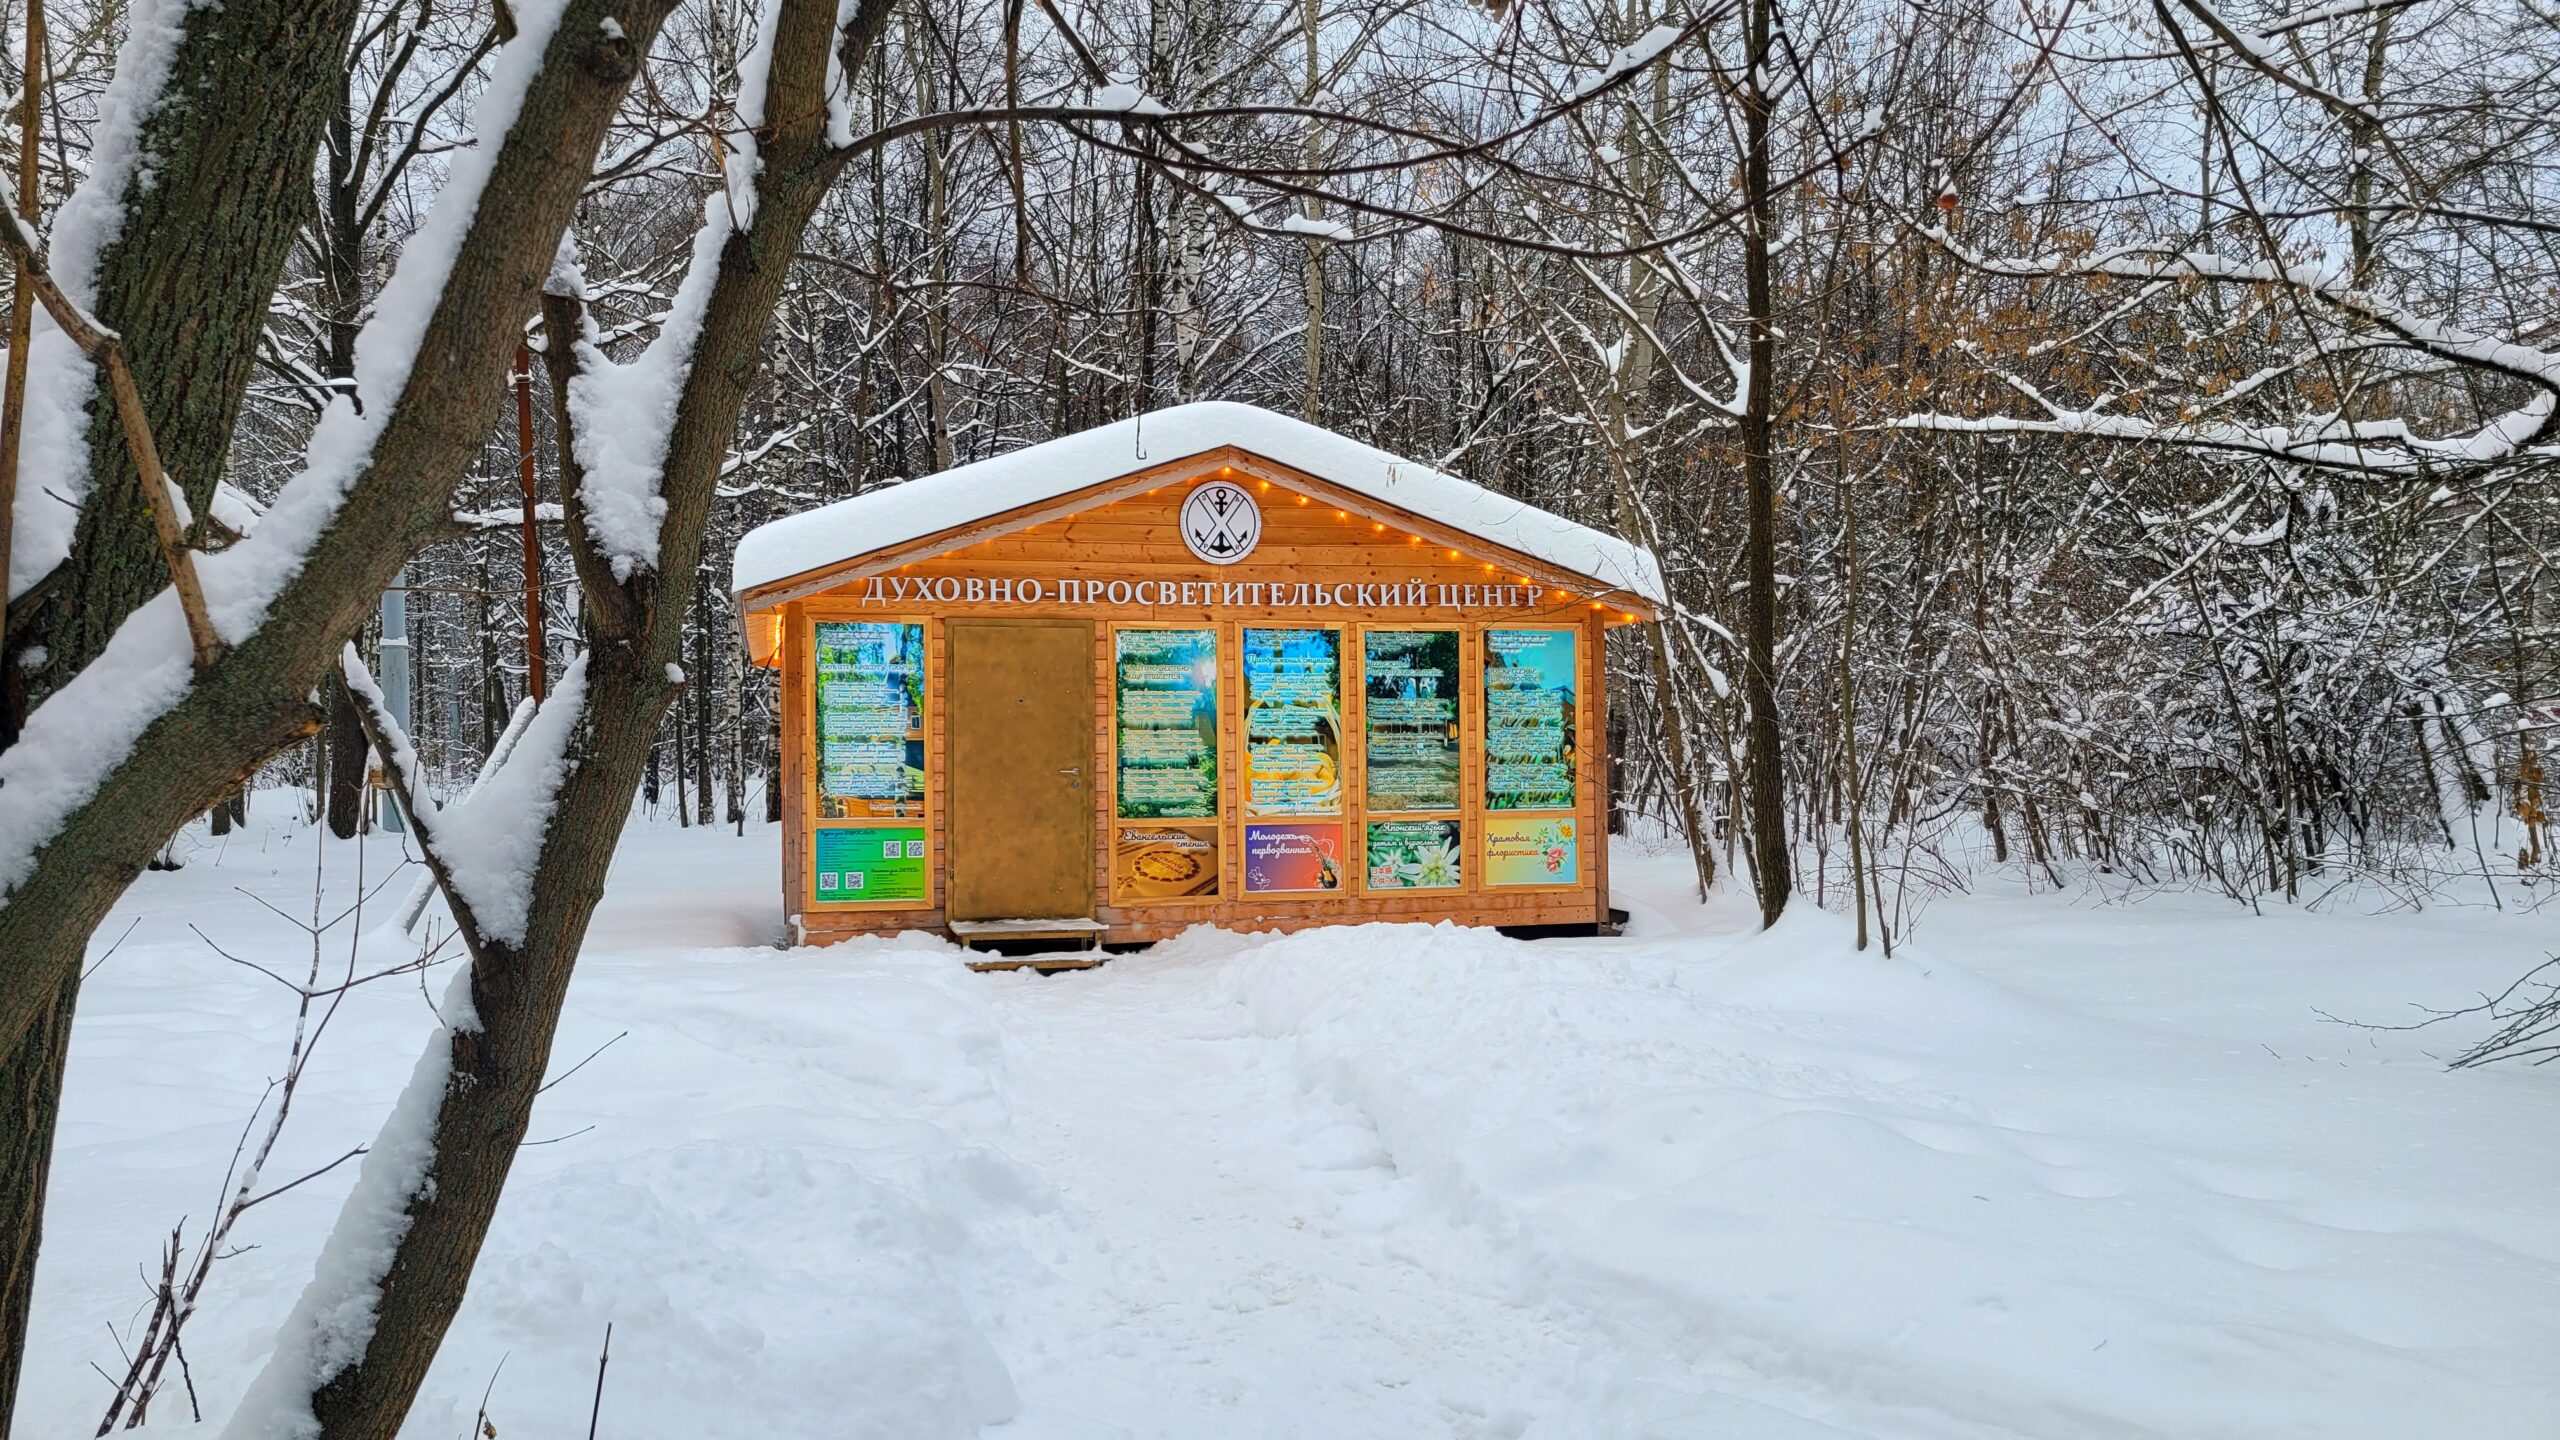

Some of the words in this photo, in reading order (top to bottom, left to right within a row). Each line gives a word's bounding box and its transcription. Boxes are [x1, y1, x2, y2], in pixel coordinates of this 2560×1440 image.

[861, 576, 1428, 607] ДУХОВНО-ПРОСВЕТИТЕЛЬСКИЙ
[1438, 583, 1544, 612] ЦЕНТР
[1123, 829, 1188, 841] Евангельские
[1381, 821, 1422, 832] Японский
[1424, 823, 1446, 835] язык
[1174, 840, 1209, 848] чтения
[1372, 840, 1398, 850] детям
[1404, 837, 1440, 850] взрослым
[1486, 832, 1531, 847] Храмовая
[1251, 843, 1312, 859] первозванная
[1486, 847, 1540, 861] флористика
